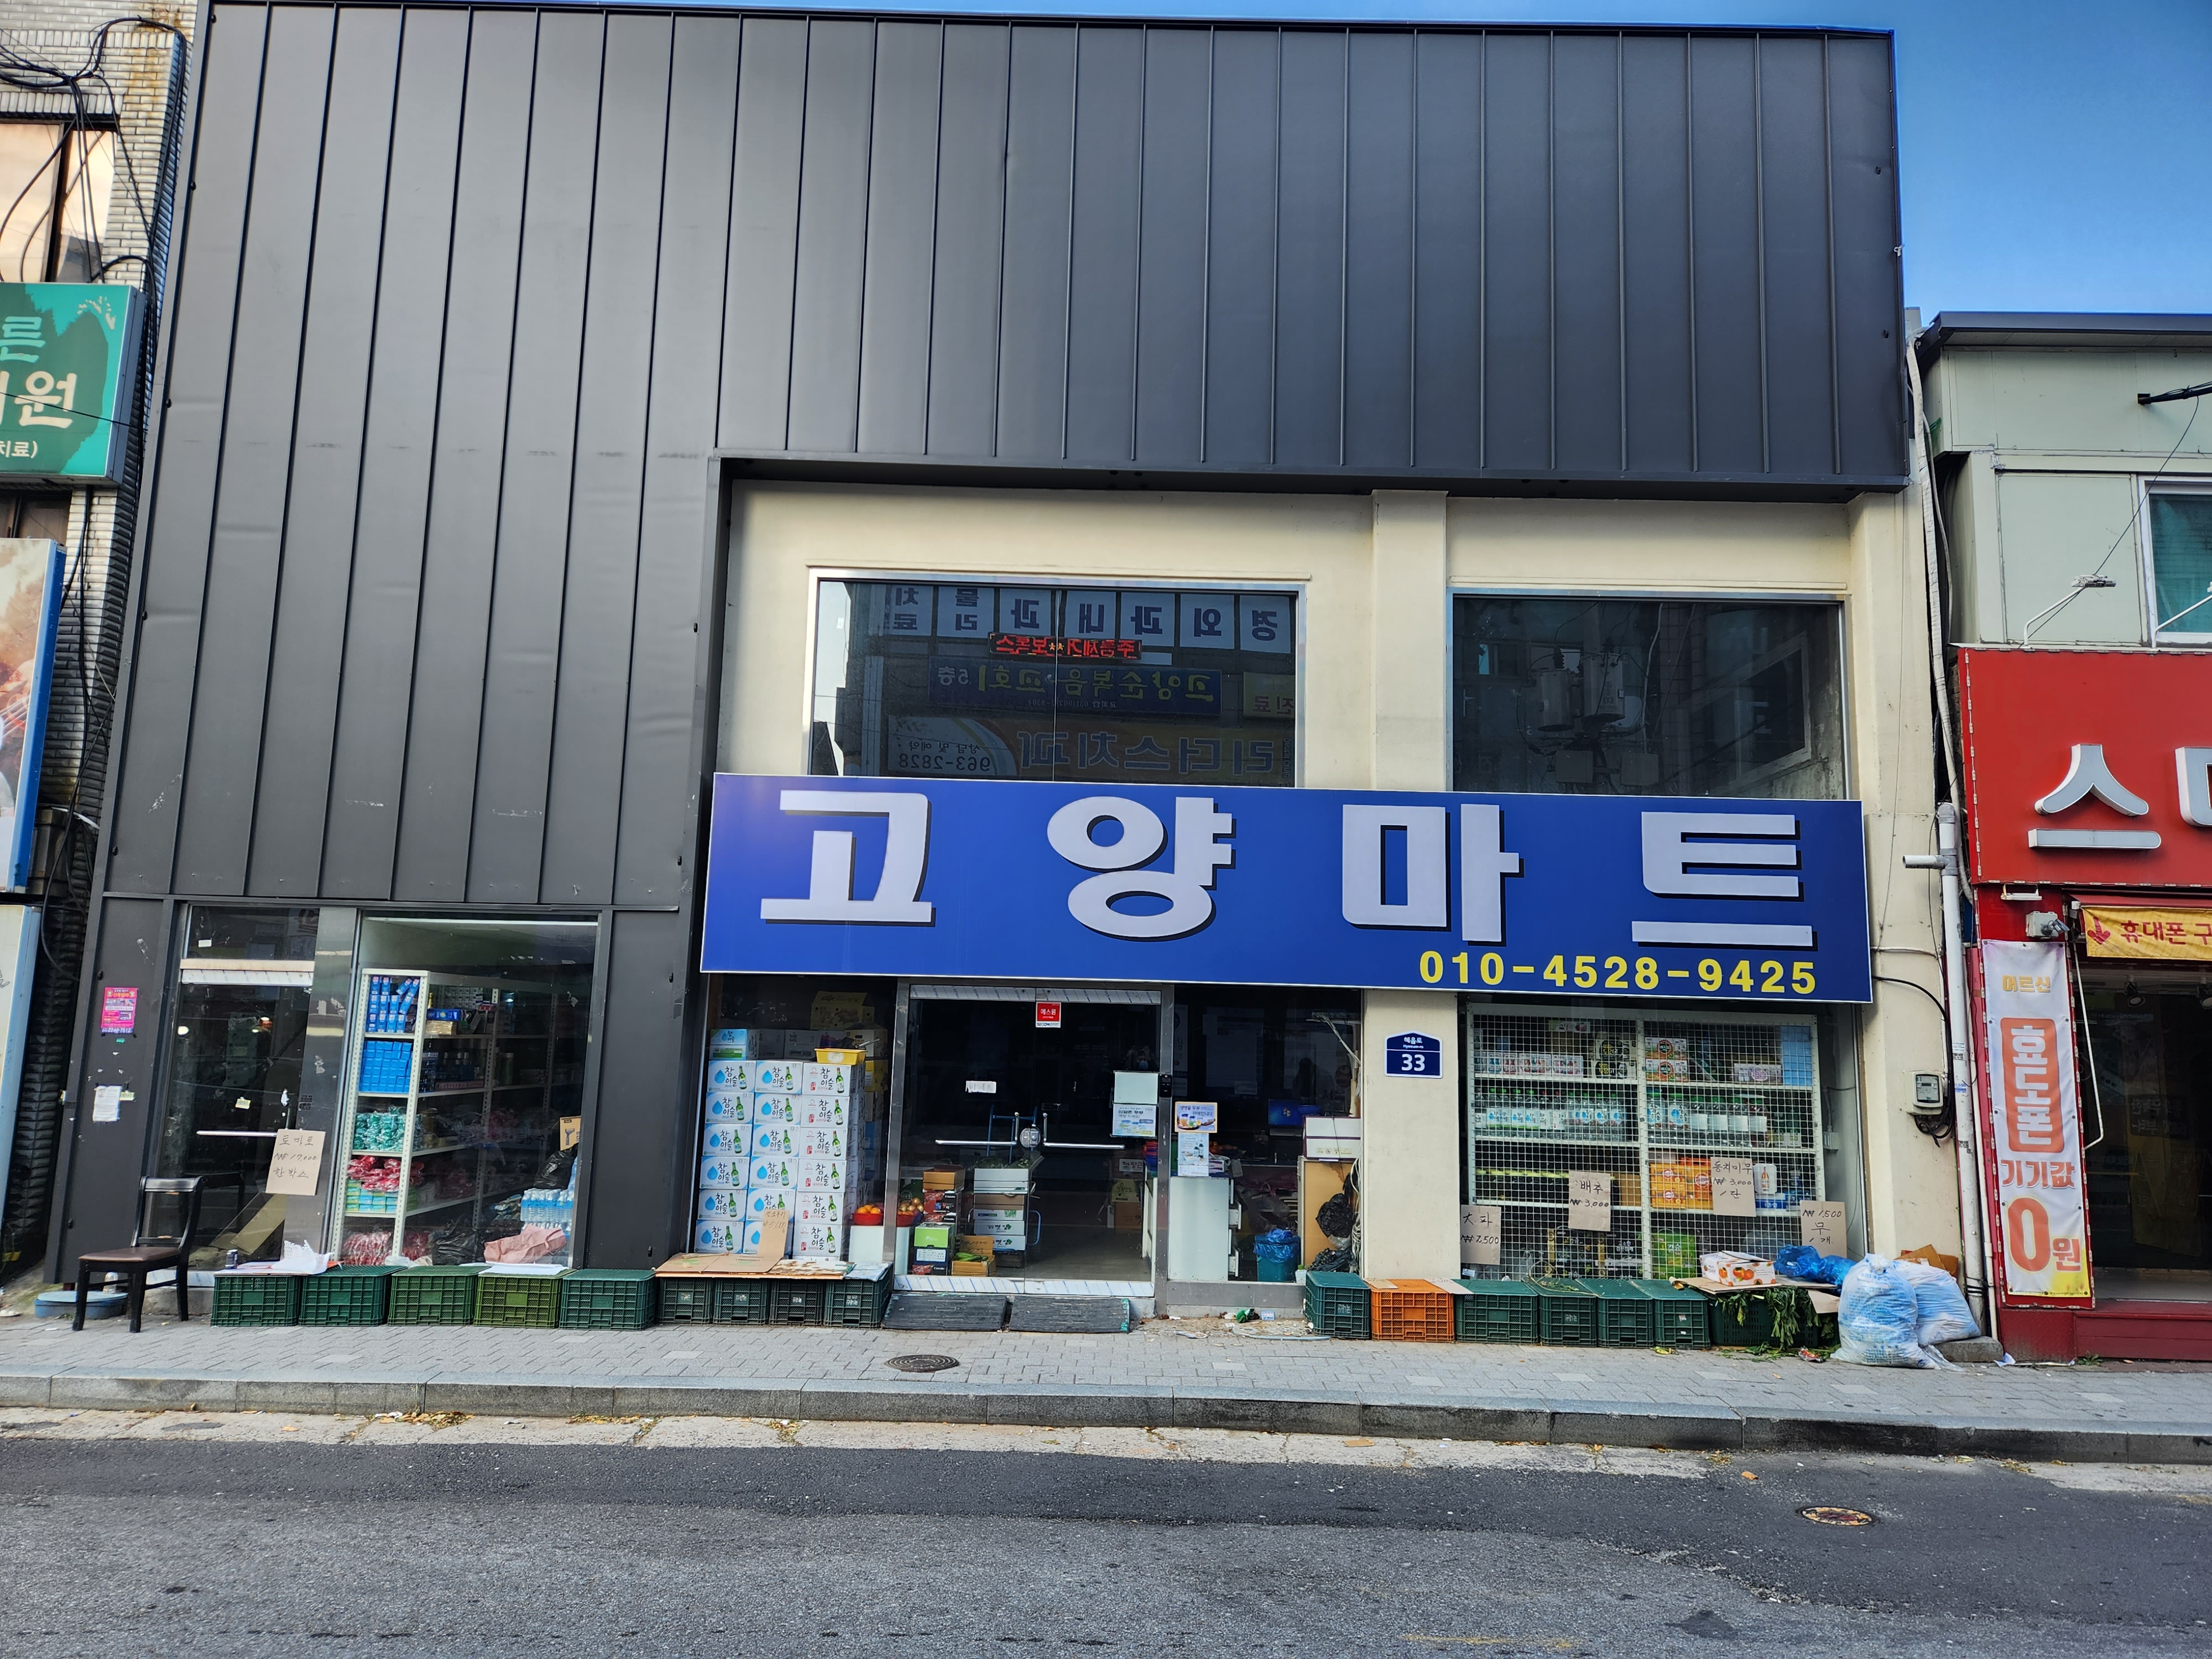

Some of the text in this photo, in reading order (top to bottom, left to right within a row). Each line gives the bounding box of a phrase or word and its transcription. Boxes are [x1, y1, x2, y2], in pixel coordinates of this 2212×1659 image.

[760, 790, 1815, 945] 고양마트
[2120, 920, 2187, 945] 휴대폰
[1419, 951, 1817, 996] 010-4528-9425
[2002, 974, 2051, 993] 어르신
[1404, 1036, 1423, 1045] 혜음로
[1401, 1053, 1425, 1071] 33
[2011, 1025, 2052, 1145] 효도폰
[279, 1135, 314, 1146] 토마토
[2000, 1160, 2077, 1190] 기기값
[1580, 1180, 1603, 1194] 배추
